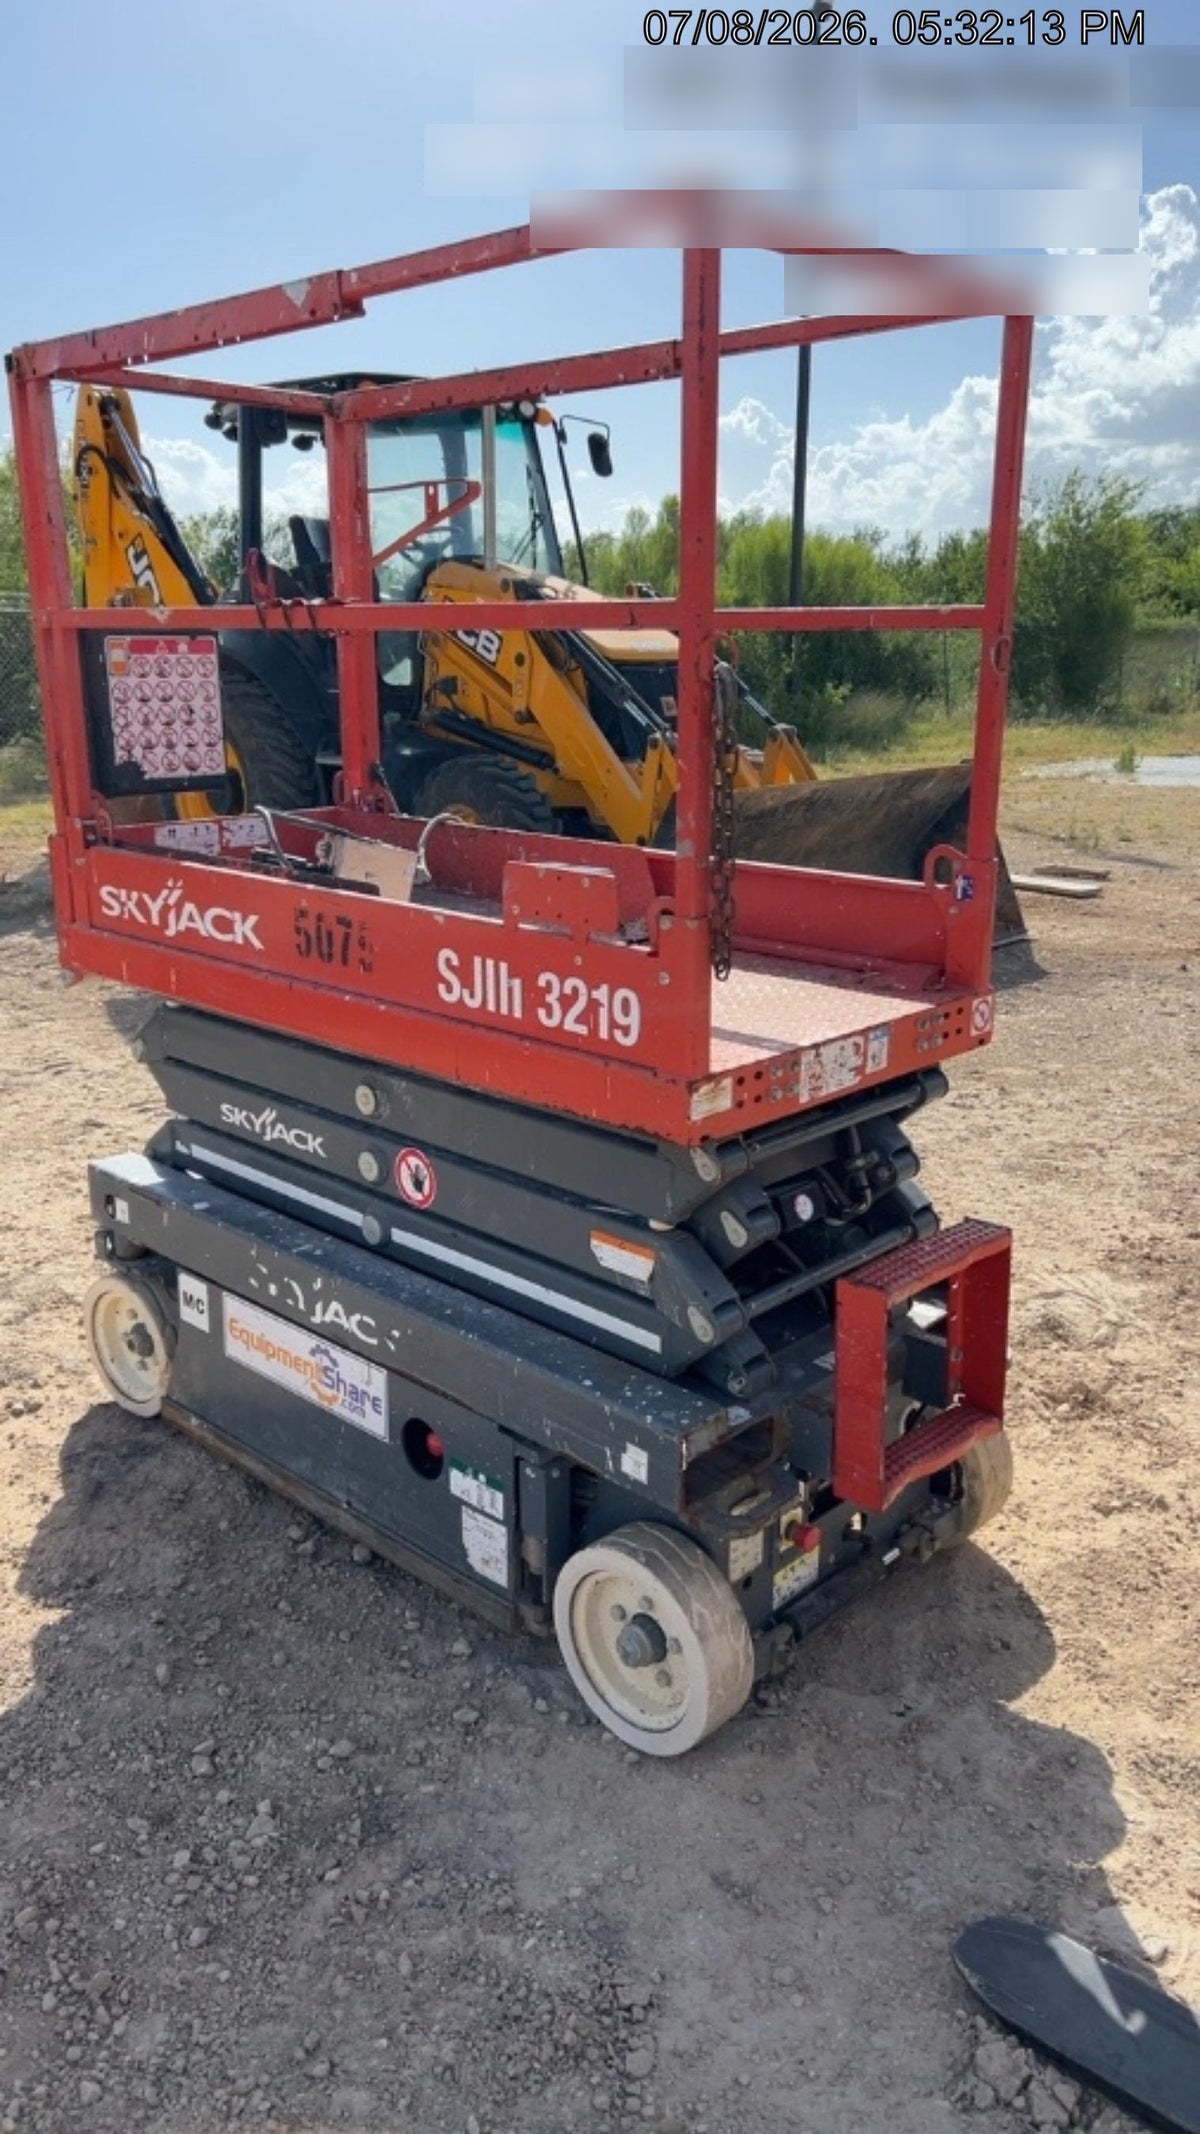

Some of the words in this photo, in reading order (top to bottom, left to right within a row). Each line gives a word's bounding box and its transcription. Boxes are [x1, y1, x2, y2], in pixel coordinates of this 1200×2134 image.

[456, 629, 500, 662] CB
[99, 878, 264, 950] SKYJACK
[537, 971, 641, 1047] 3219
[220, 1102, 328, 1158] SKYJACK
[323, 1364, 383, 1416] Share
